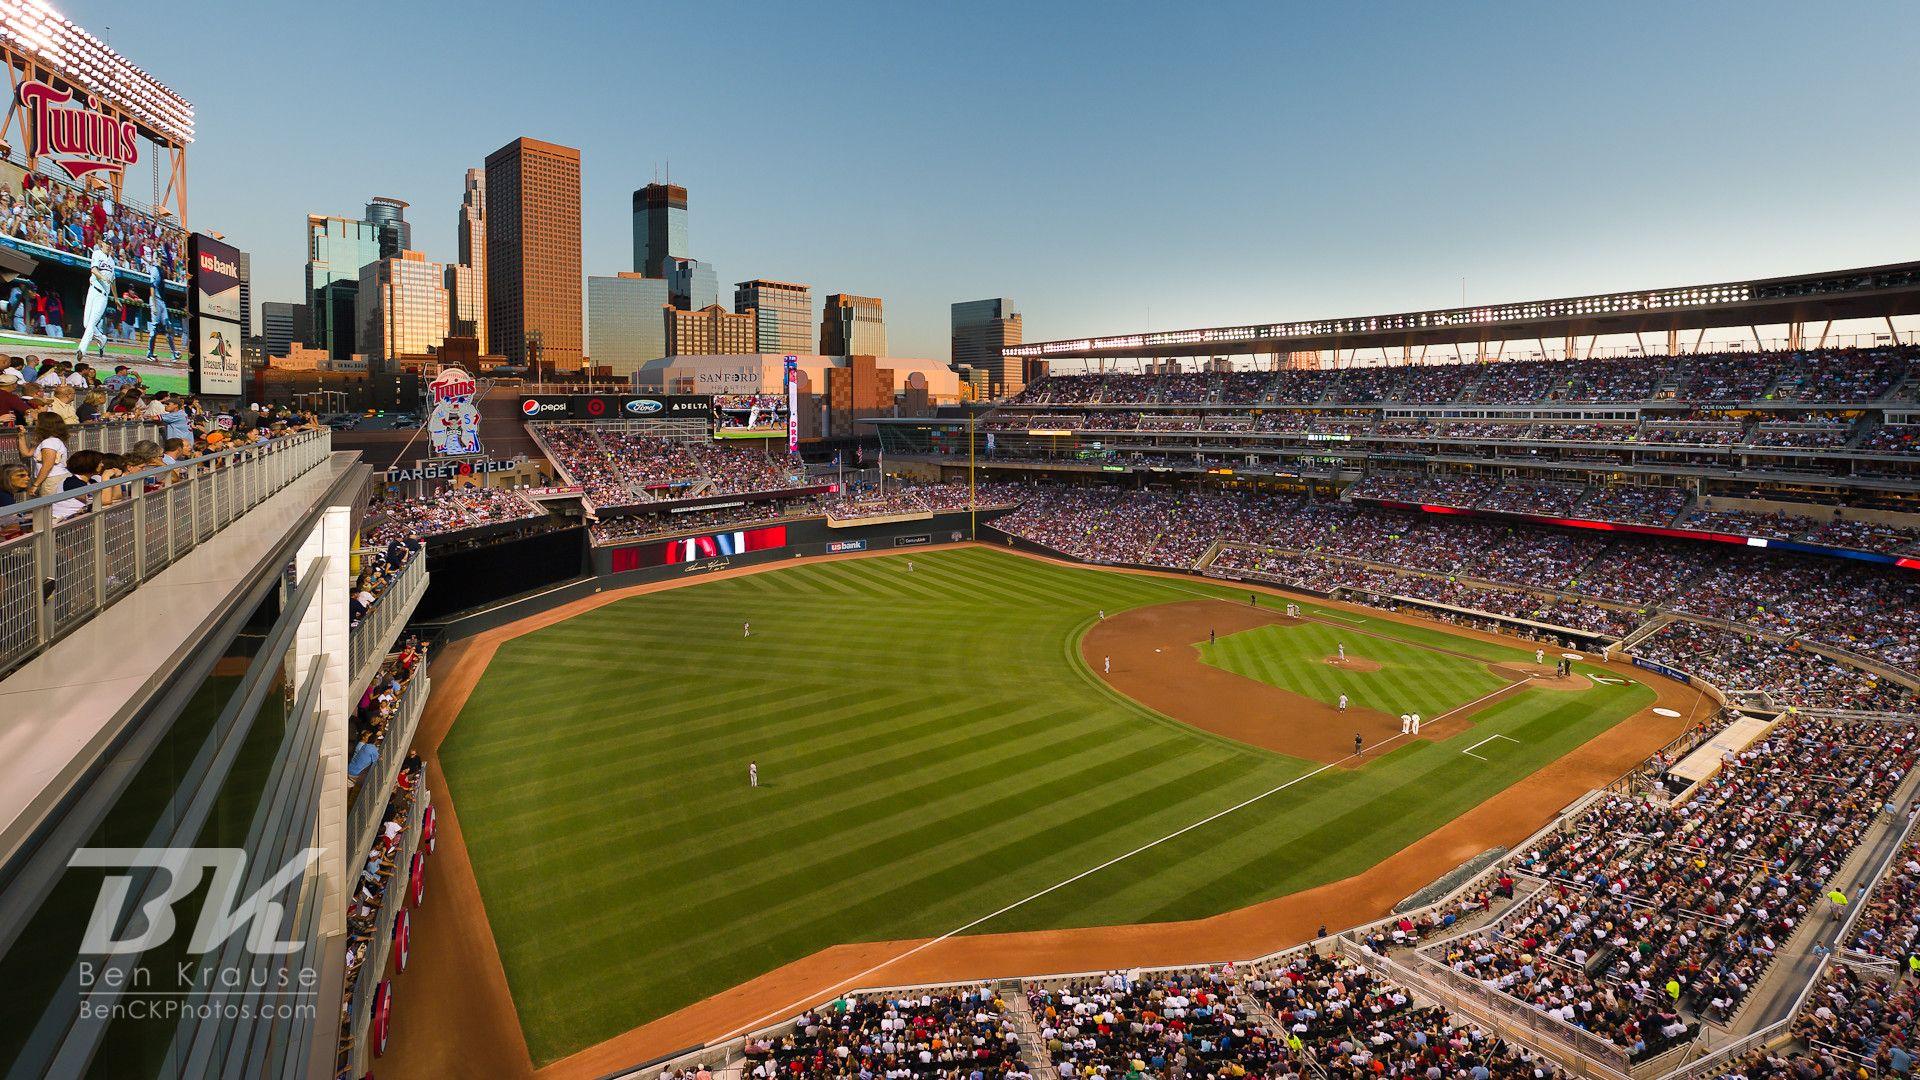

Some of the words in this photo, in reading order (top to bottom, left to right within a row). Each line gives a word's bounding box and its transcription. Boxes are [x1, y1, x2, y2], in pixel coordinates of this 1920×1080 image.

[19, 80, 138, 165] Twins
[203, 356, 222, 370] Treasure
[700, 373, 757, 383] SANFORD
[429, 379, 475, 403] Twins
[540, 403, 567, 412] pepsi
[632, 402, 656, 412] Ford
[681, 402, 708, 410] DELTA
[390, 465, 458, 483] TARGET
[474, 460, 517, 474] FIELD
